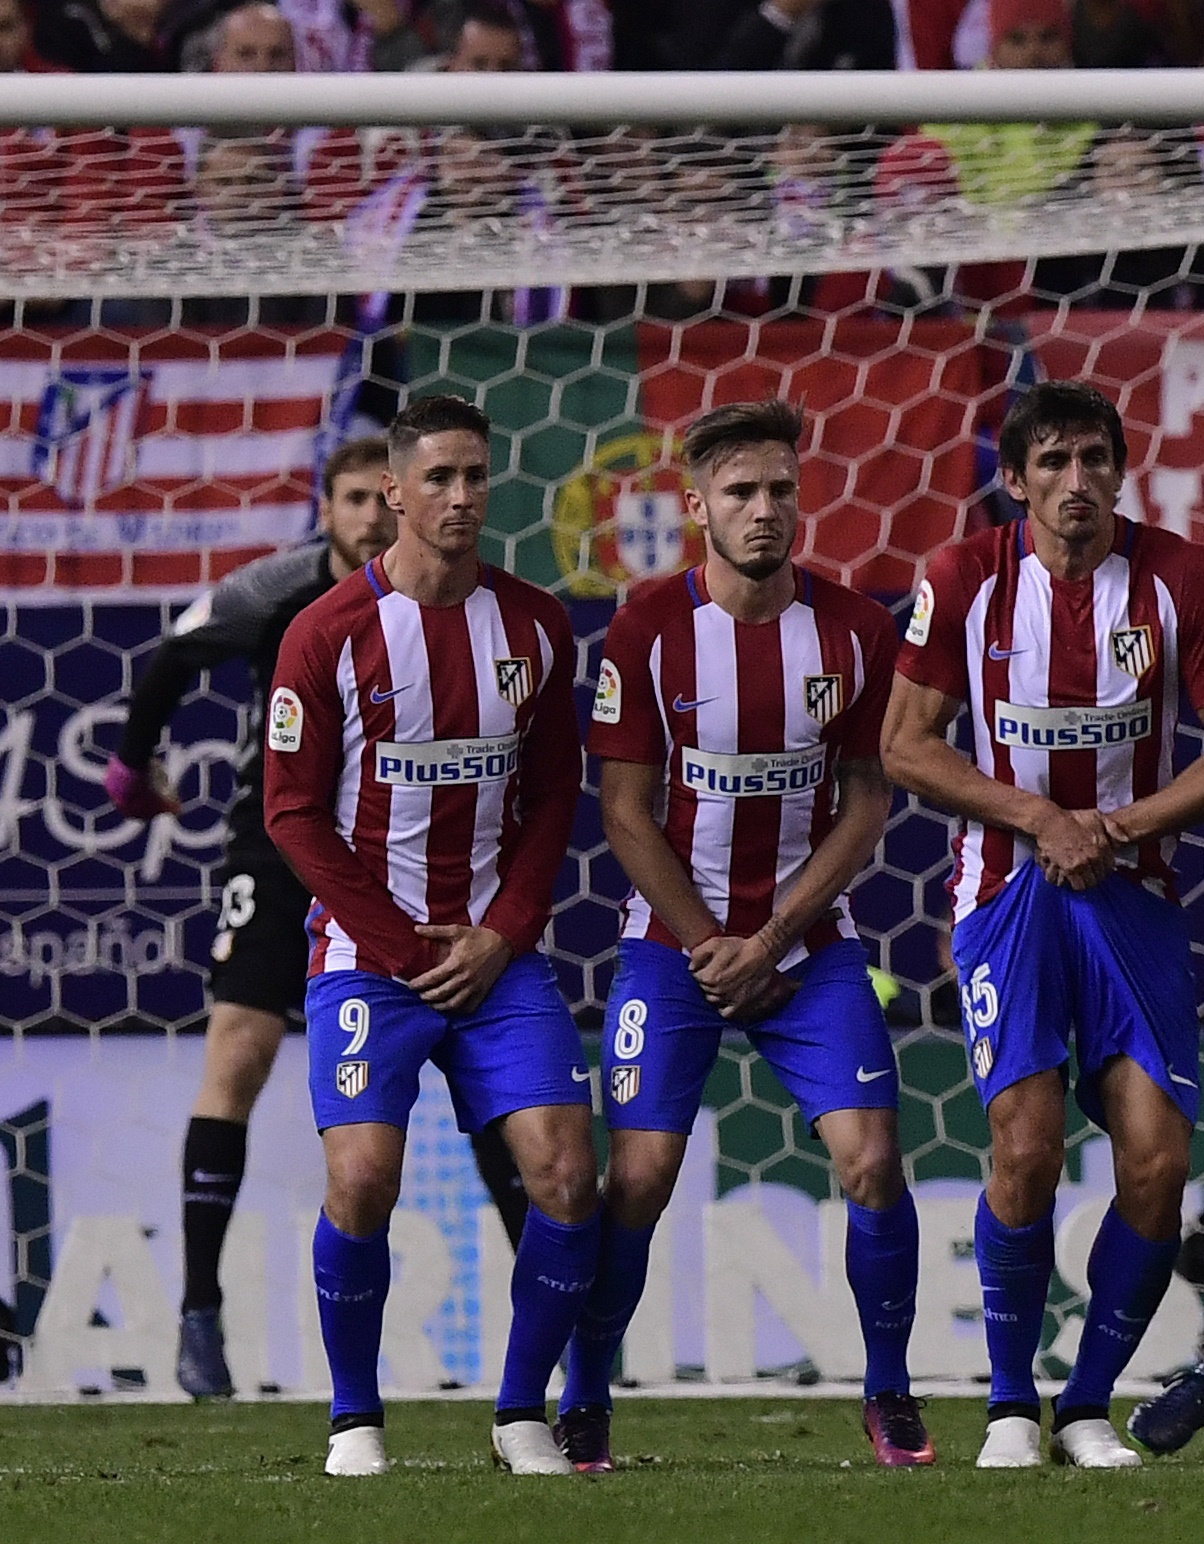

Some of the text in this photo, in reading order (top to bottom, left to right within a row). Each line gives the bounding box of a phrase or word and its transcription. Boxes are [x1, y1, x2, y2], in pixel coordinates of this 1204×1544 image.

[999, 715, 1149, 746] Plus500
[379, 748, 516, 782] Plus500
[466, 743, 496, 754] Trade
[686, 760, 823, 793] Plus500
[338, 998, 371, 1057] 9
[614, 999, 648, 1060] 8
